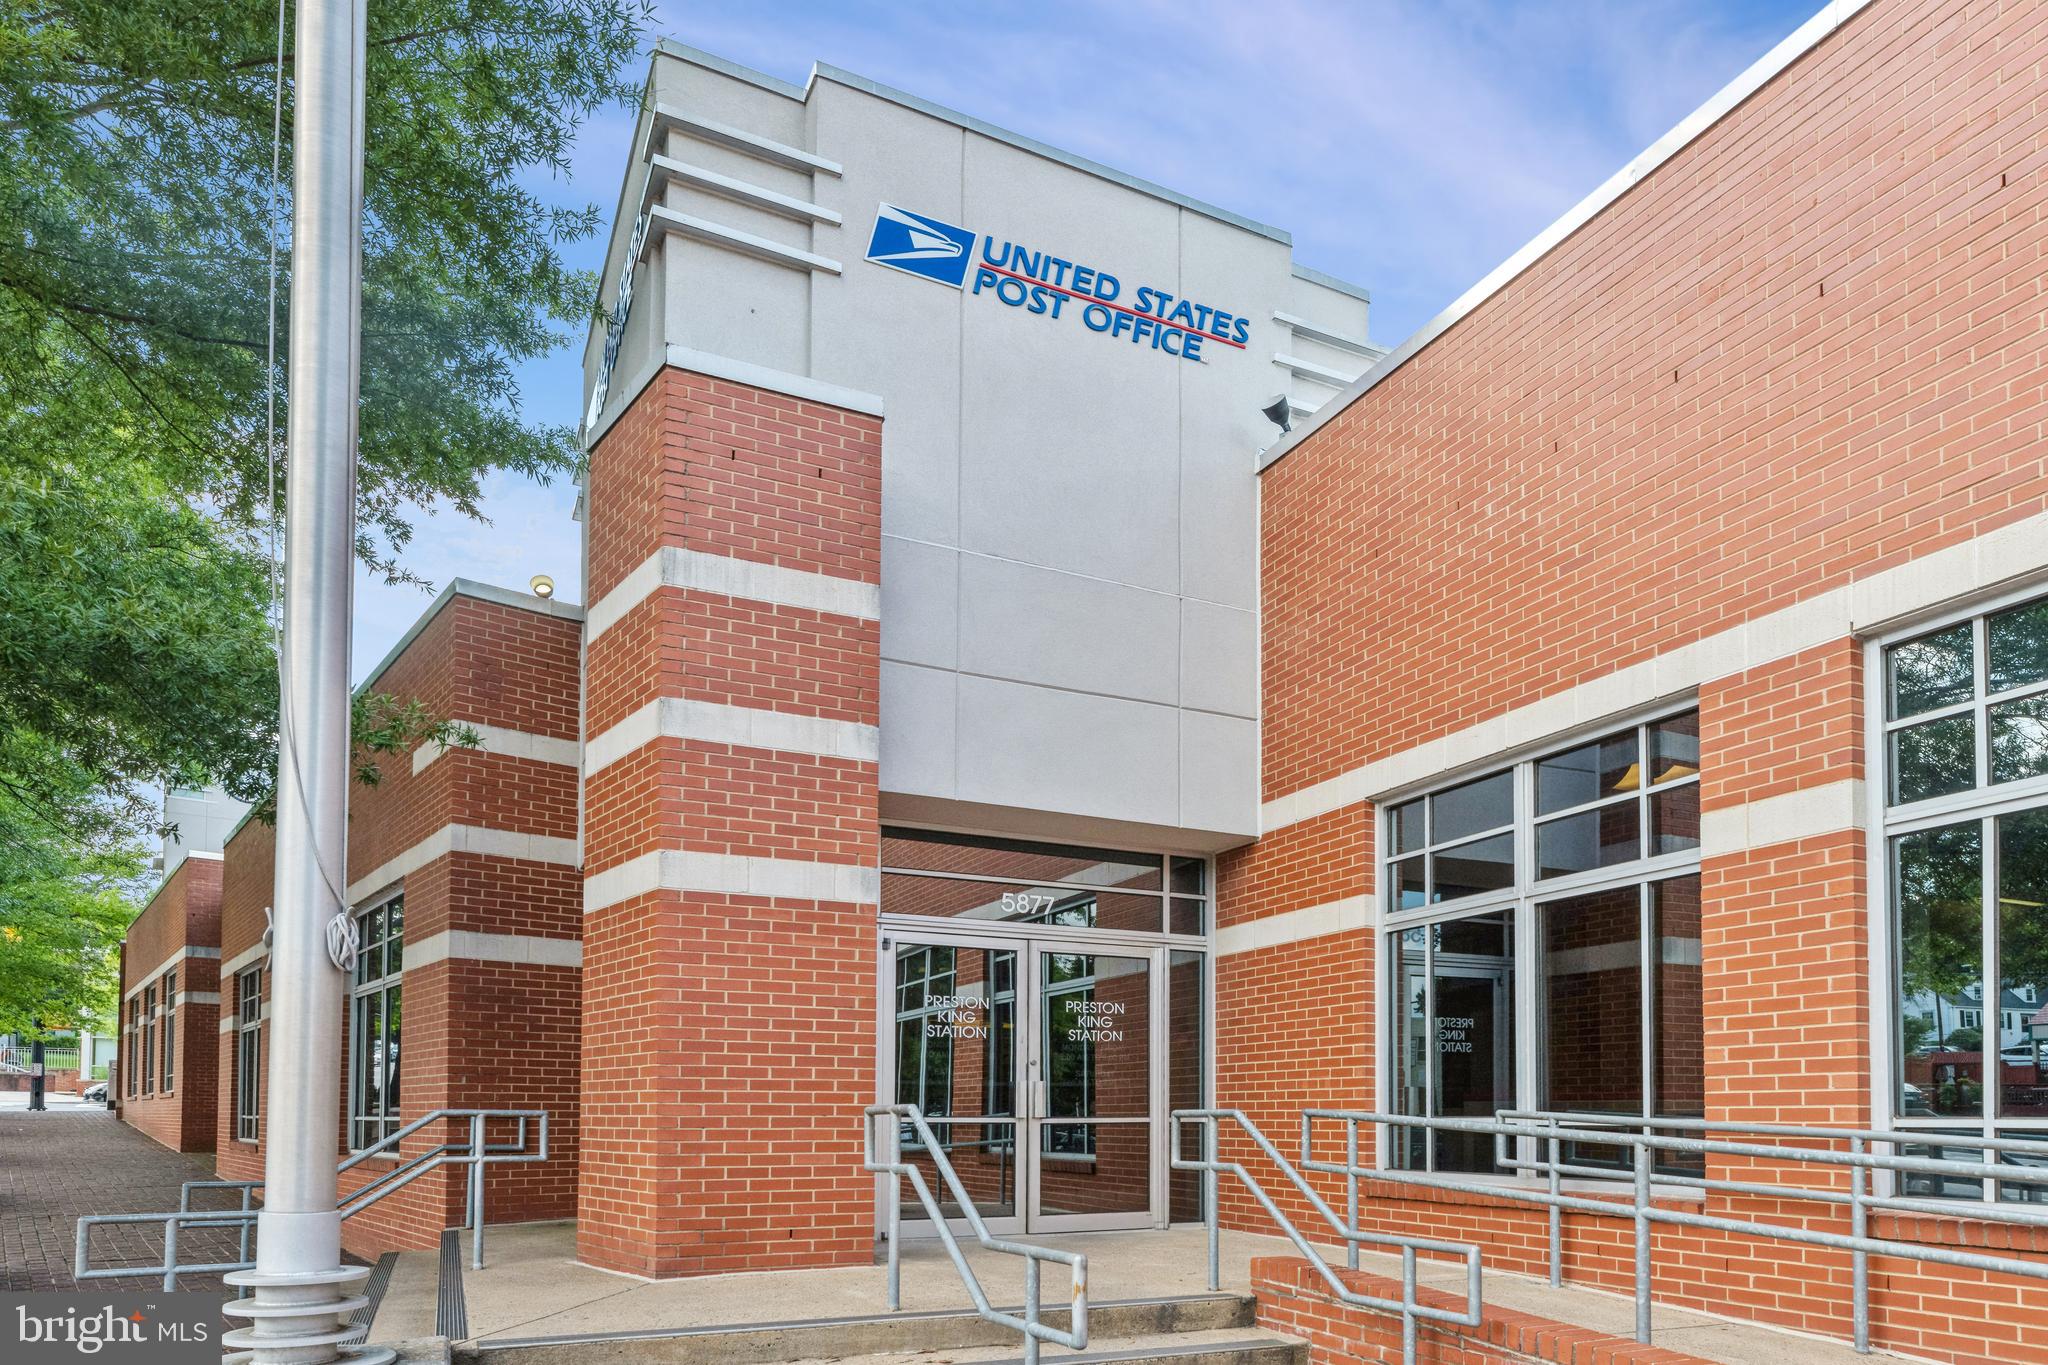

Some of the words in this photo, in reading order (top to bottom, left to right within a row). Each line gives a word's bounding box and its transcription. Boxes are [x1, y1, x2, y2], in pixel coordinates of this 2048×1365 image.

[983, 236, 1120, 301] UNITED
[1134, 286, 1250, 344] STATES
[973, 268, 1070, 319] POST
[1083, 304, 1203, 362] OFFICE
[1001, 892, 1055, 914] 5877
[925, 995, 990, 1010] PRESTON
[1065, 1000, 1125, 1015] PRESTON
[937, 1011, 976, 1024] KING
[1077, 1015, 1113, 1029] KING
[926, 1024, 987, 1039] STATION
[1068, 1029, 1122, 1042] STATION
